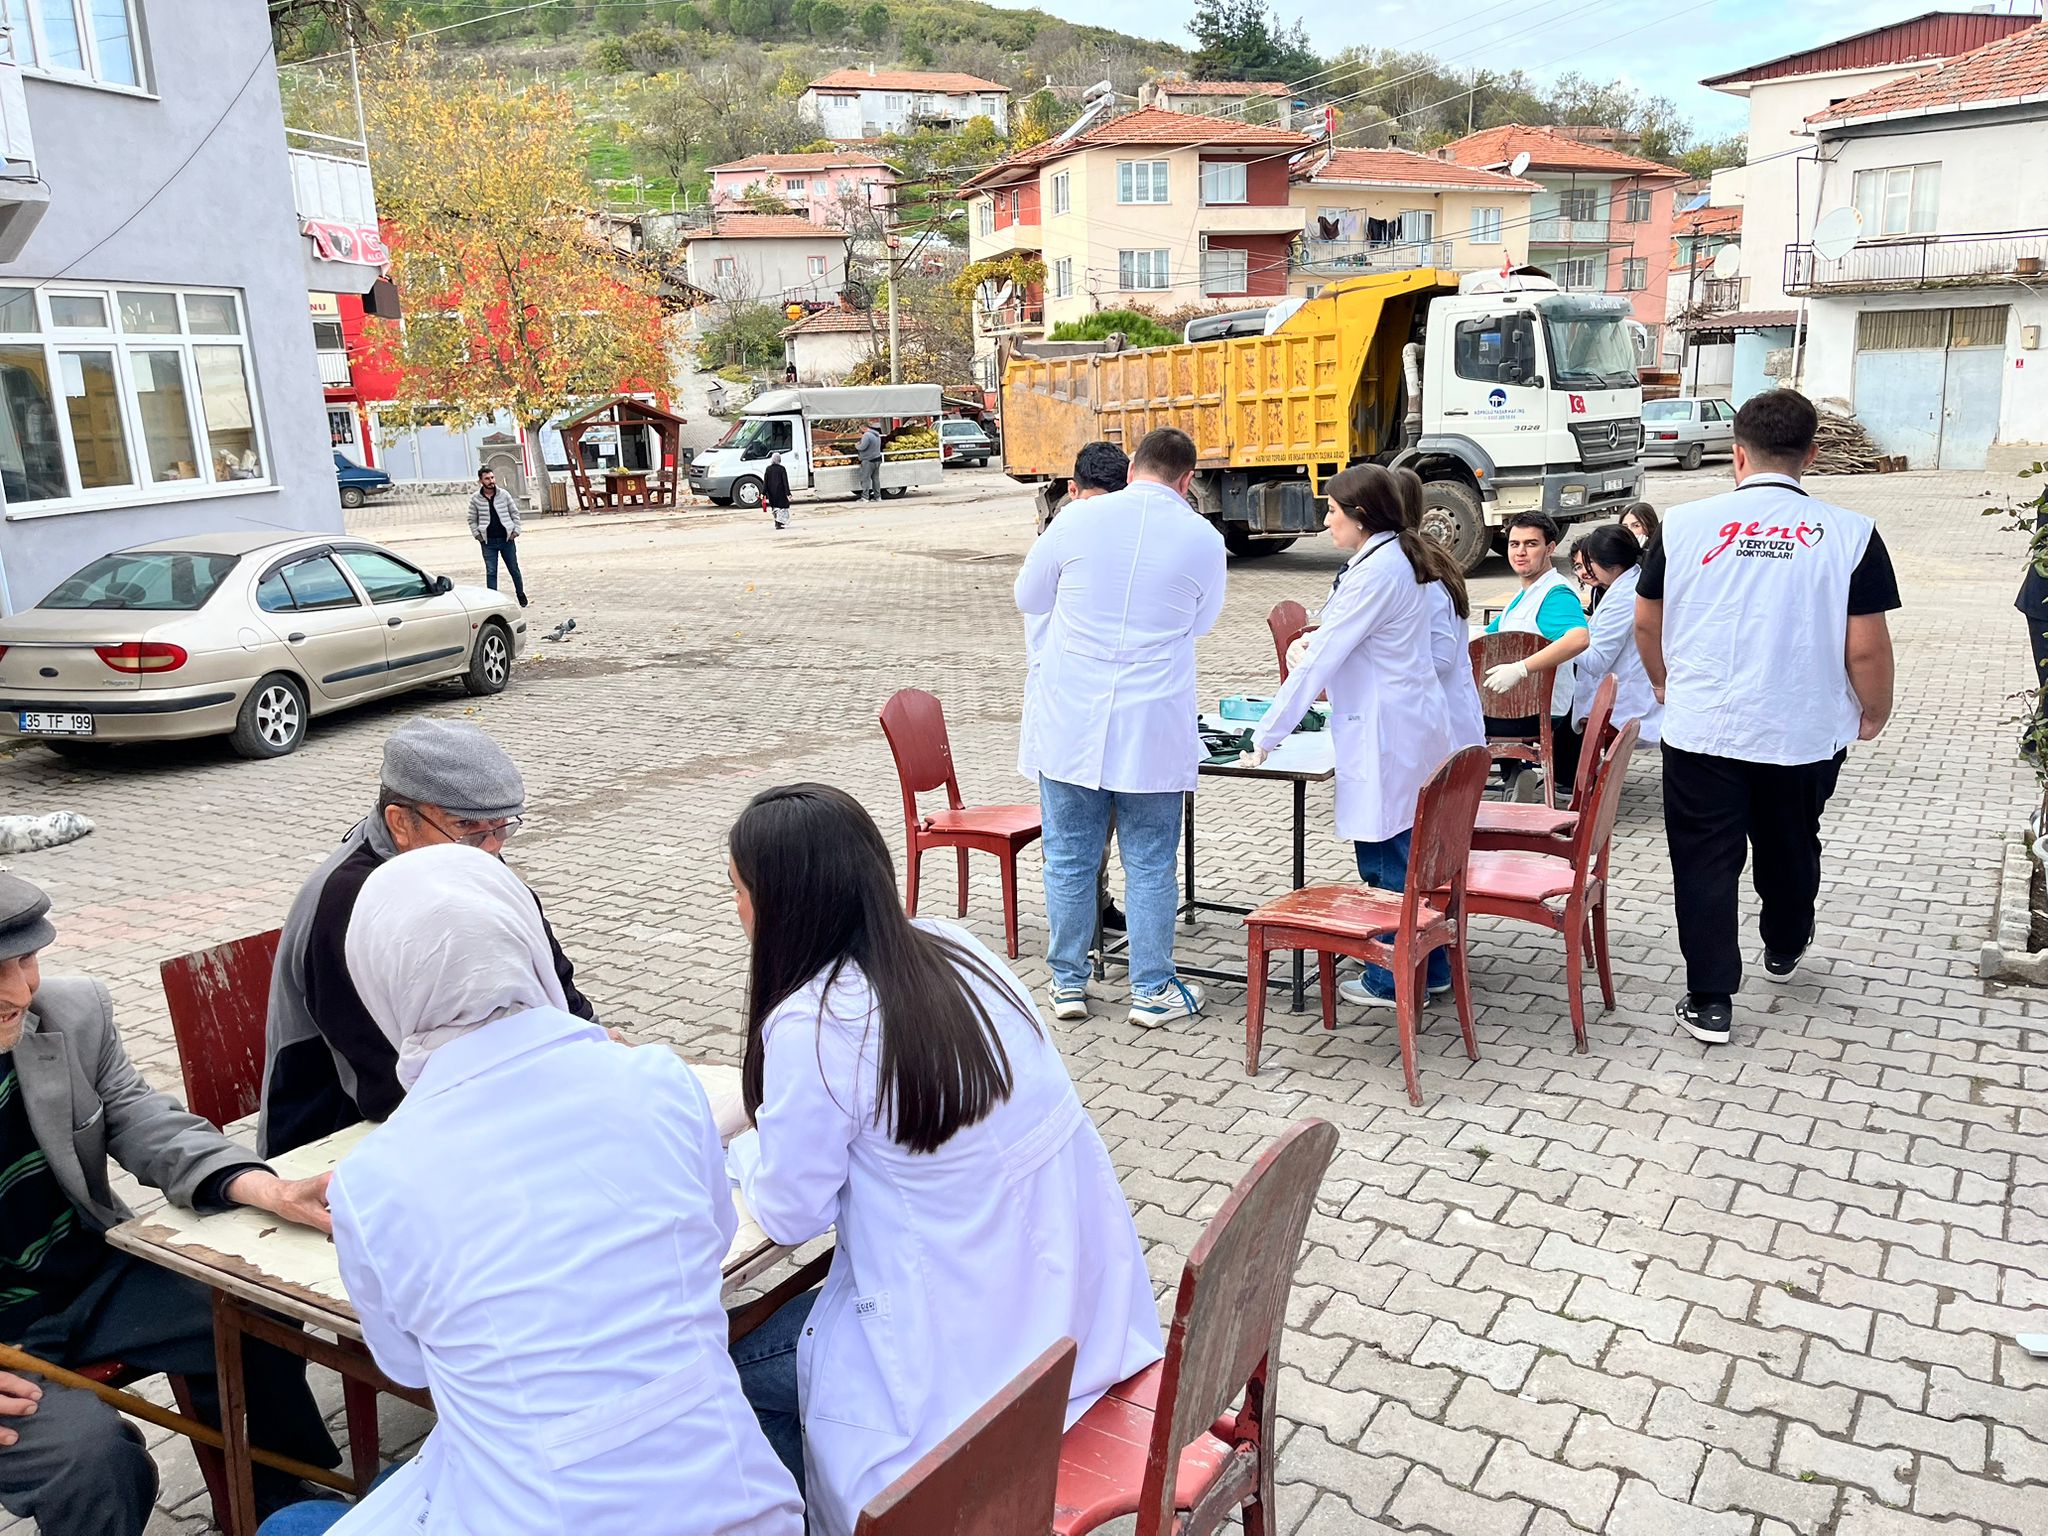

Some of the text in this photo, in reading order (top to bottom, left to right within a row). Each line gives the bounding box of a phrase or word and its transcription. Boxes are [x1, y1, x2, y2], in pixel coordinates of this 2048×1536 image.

[26, 714, 91, 729] 35 TF 199
